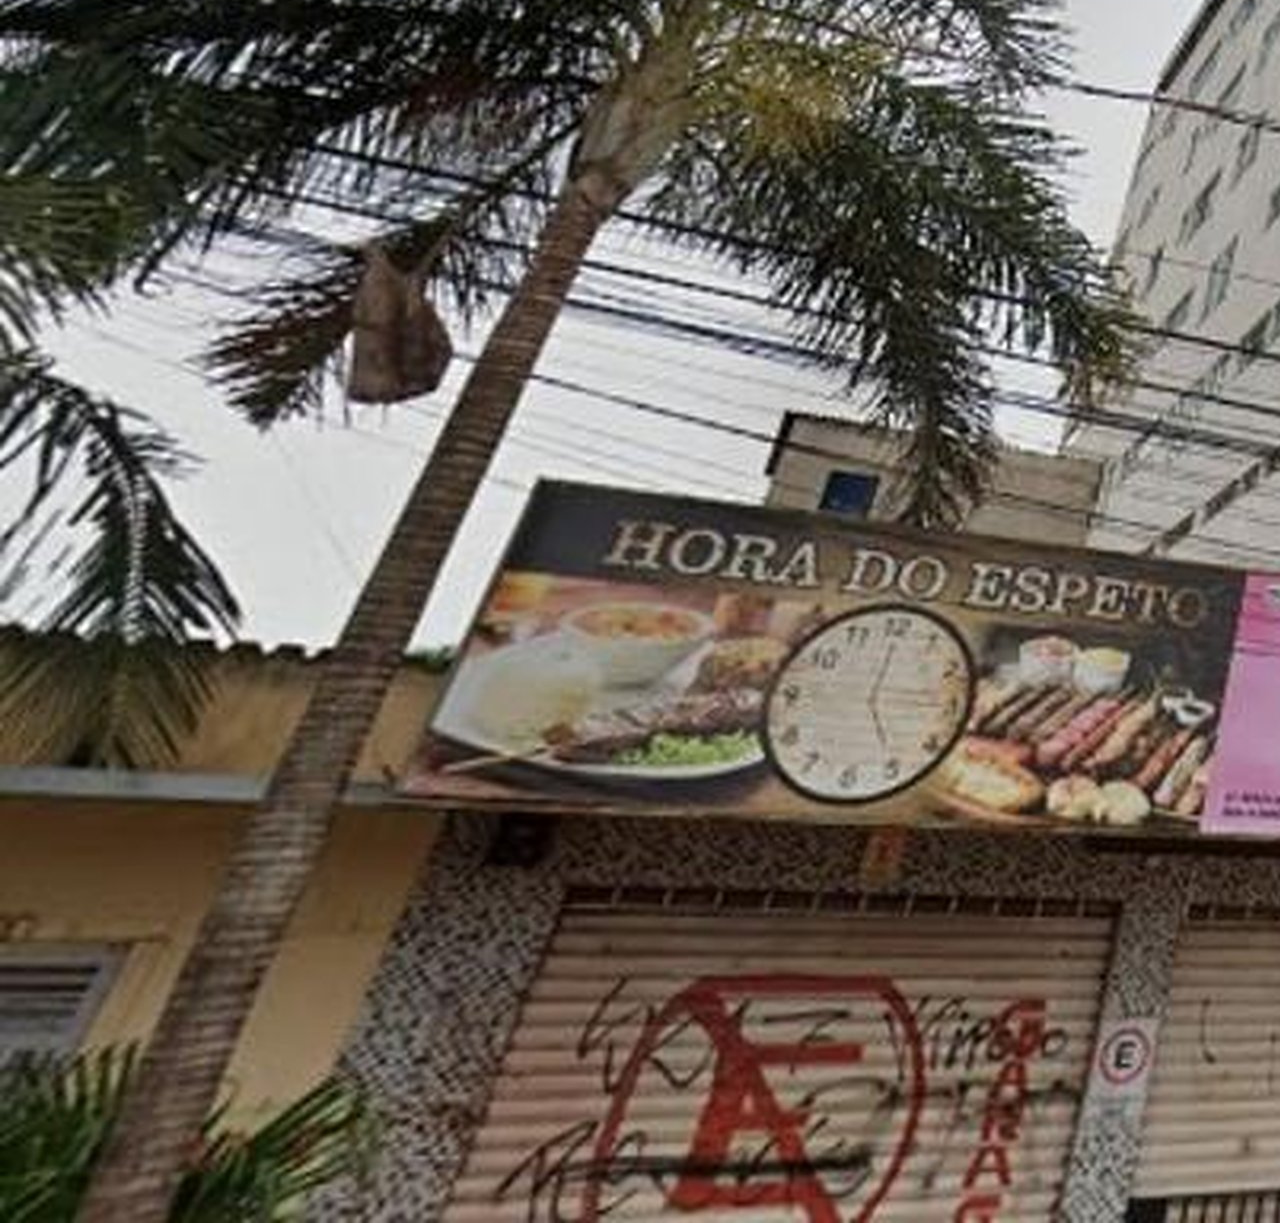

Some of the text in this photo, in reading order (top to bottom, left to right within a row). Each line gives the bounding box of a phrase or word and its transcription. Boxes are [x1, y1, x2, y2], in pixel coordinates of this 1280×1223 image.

[605, 521, 1211, 627] HORA DO ESPETO
